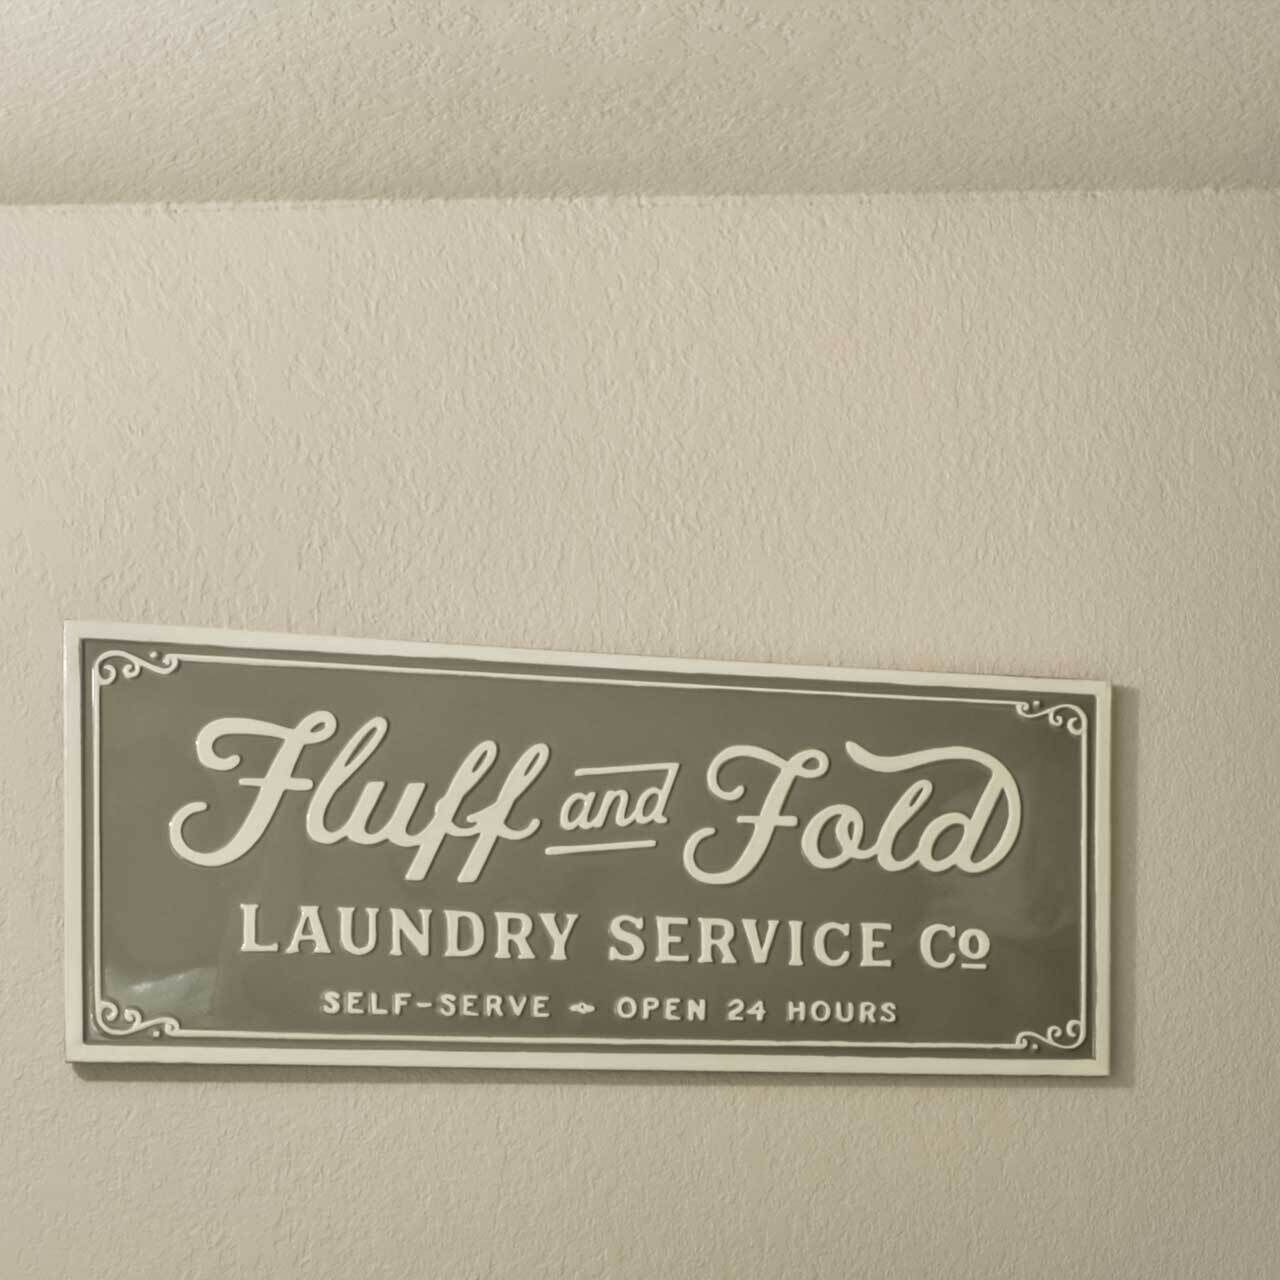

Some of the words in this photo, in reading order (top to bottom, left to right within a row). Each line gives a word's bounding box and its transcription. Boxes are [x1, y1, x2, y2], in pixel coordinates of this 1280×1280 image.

[169, 711, 551, 882] Fluff
[556, 763, 678, 835] and
[684, 741, 1022, 884] Fold
[240, 904, 578, 961] LAUNDRY
[608, 915, 892, 967] SERVICE
[919, 921, 992, 970] Co
[322, 991, 551, 1018] SELF-SERVE
[616, 996, 706, 1021] OPEN
[727, 998, 766, 1022] 24
[786, 1000, 898, 1023] HOURS
